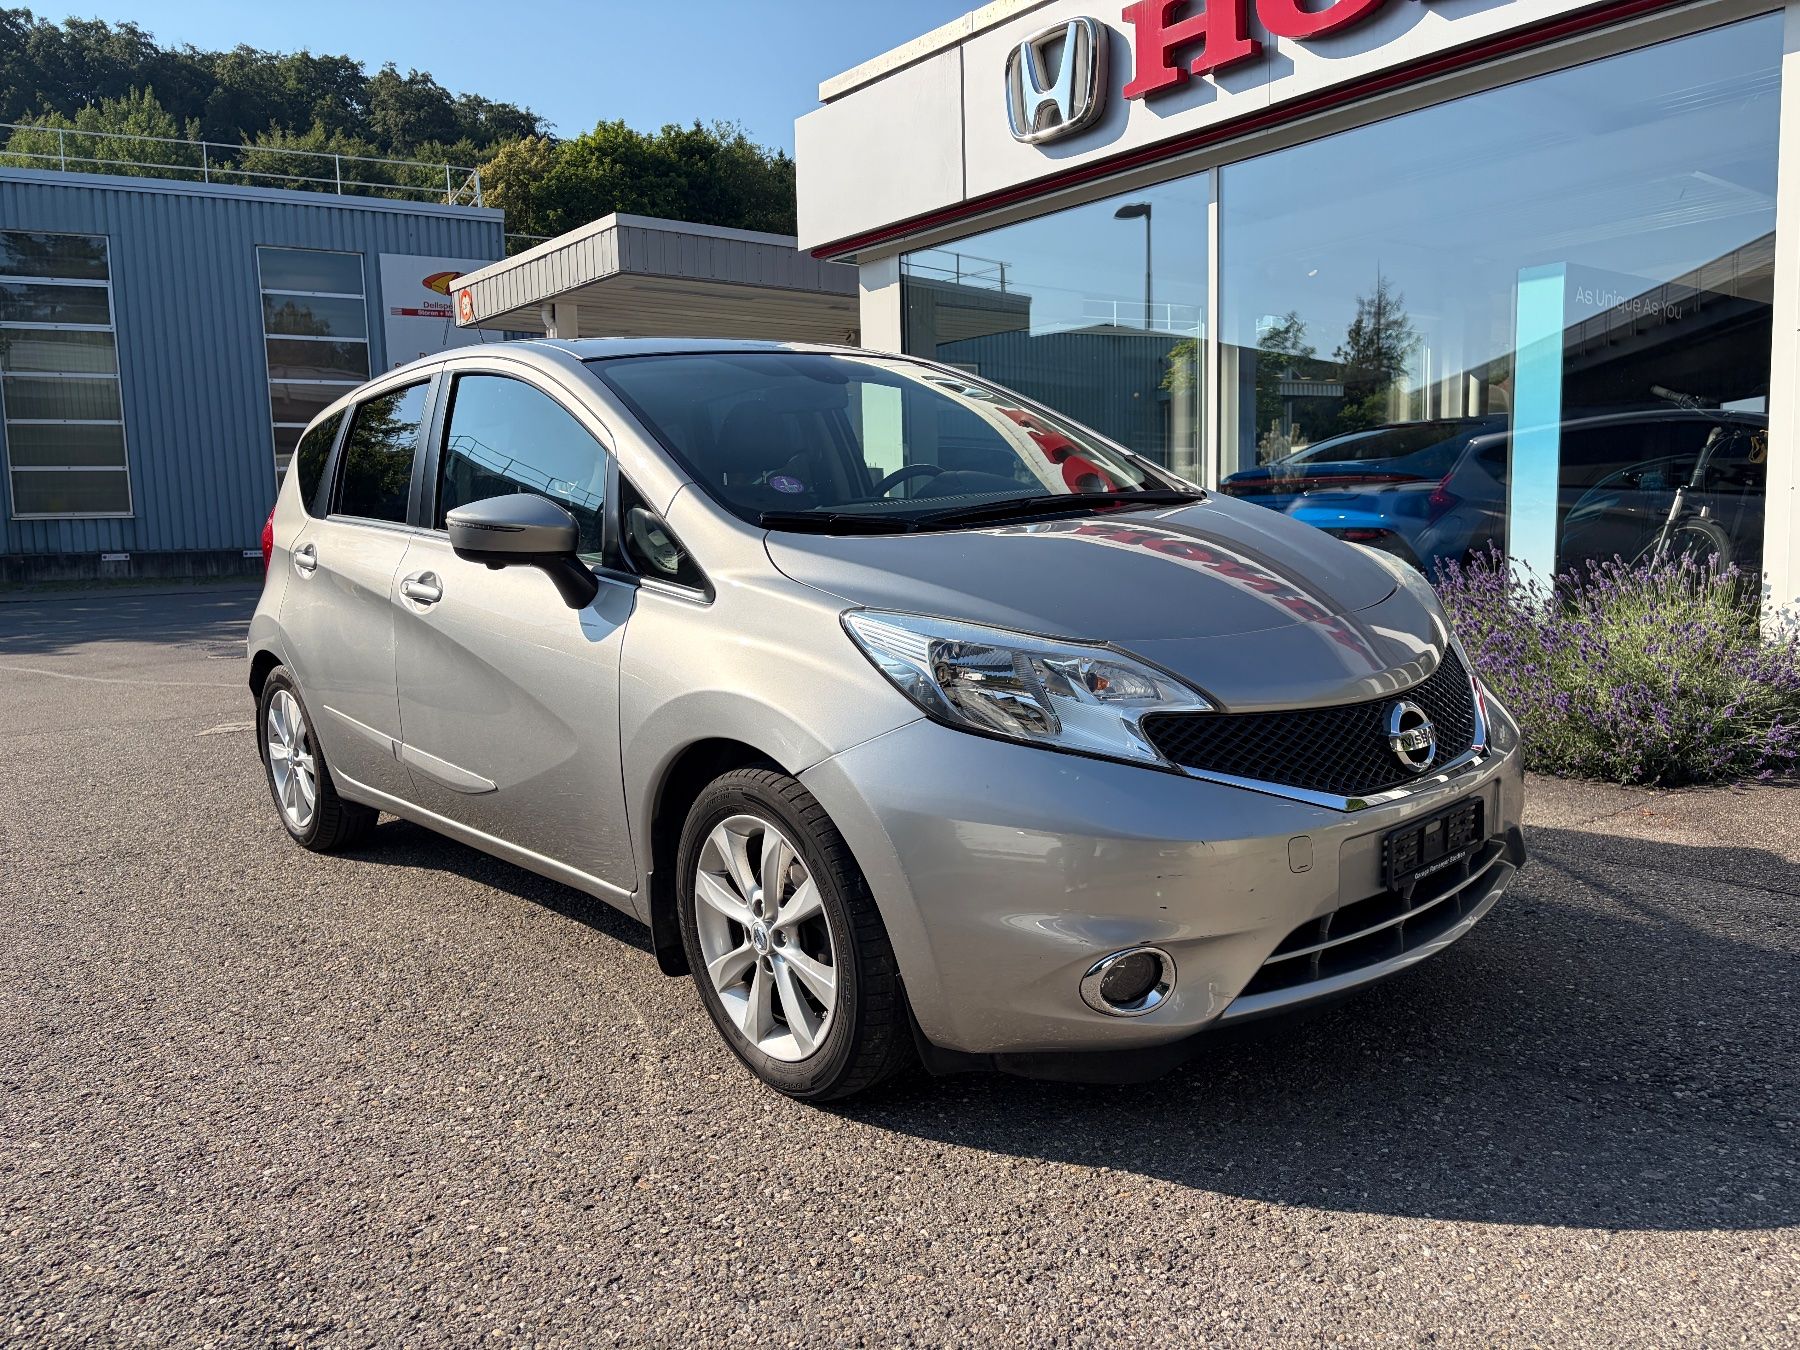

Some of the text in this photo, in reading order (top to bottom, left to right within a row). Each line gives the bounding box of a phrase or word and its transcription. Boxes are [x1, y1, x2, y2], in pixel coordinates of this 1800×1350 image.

[1575, 287, 1682, 320] As Unique As You
